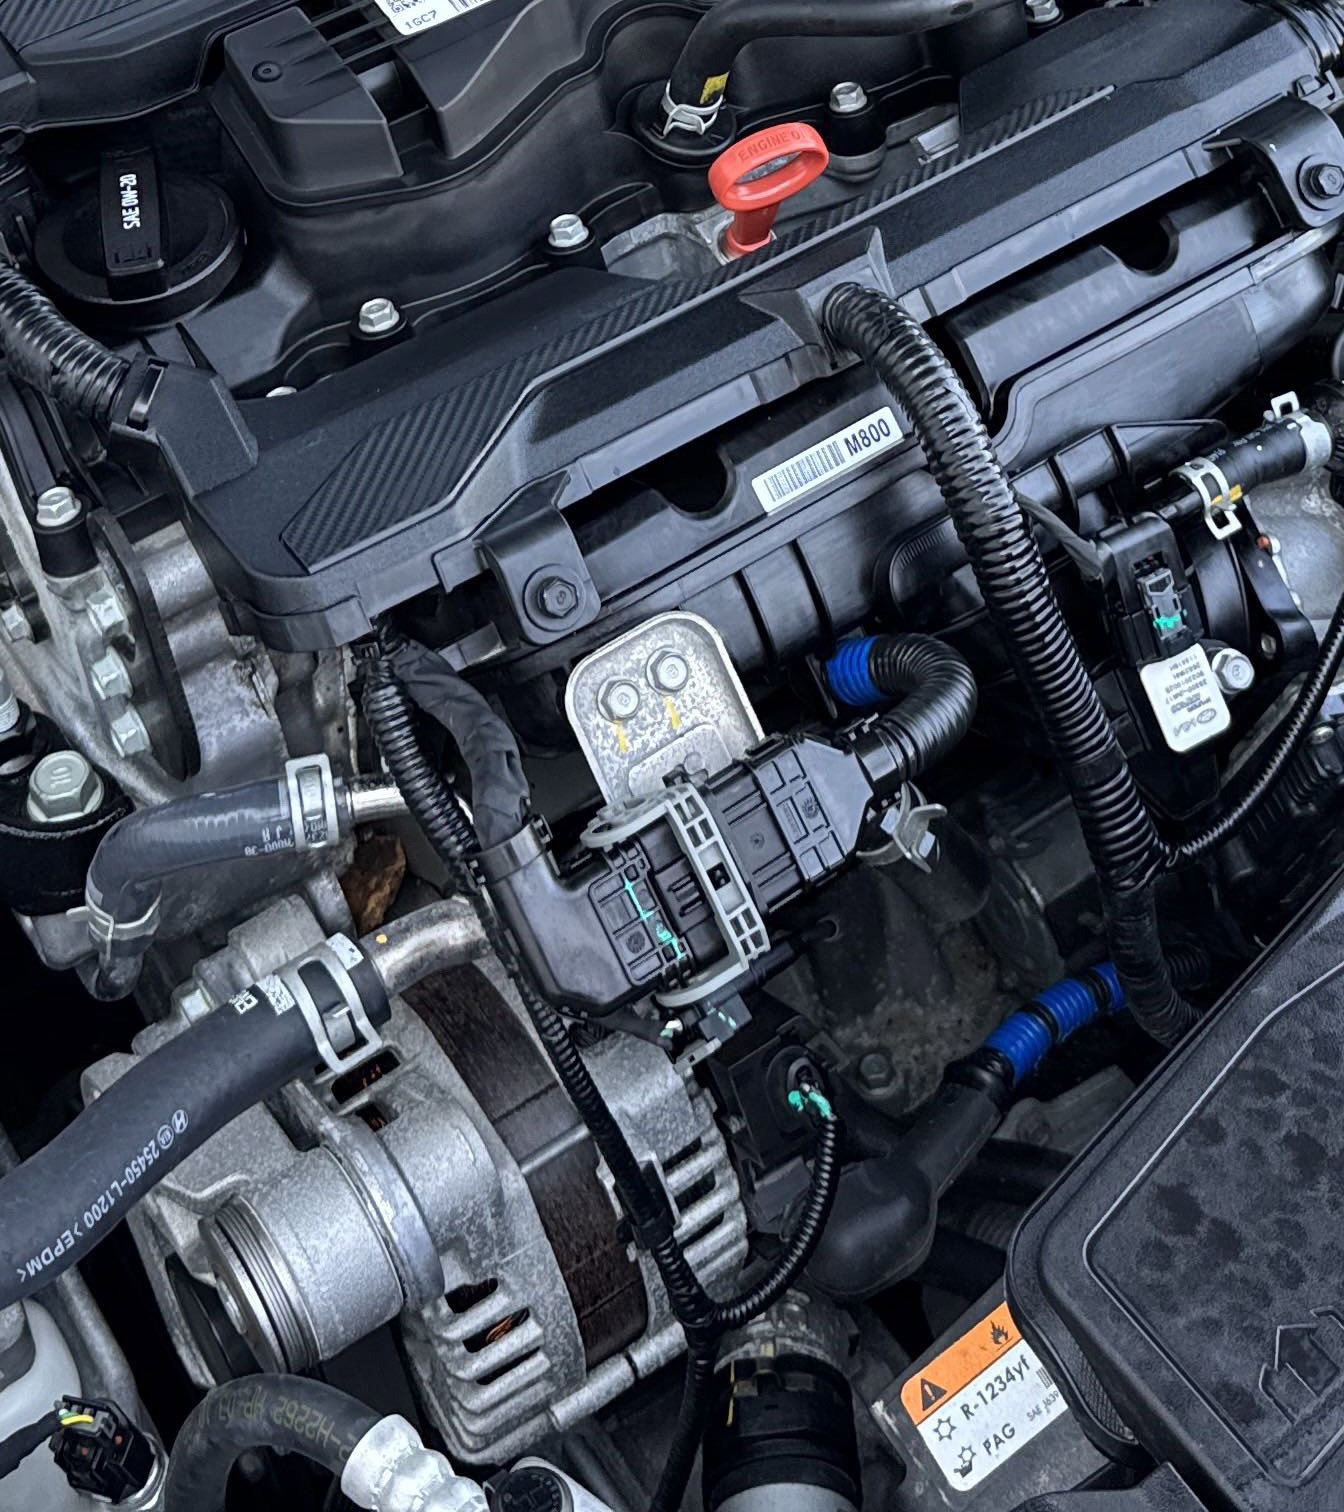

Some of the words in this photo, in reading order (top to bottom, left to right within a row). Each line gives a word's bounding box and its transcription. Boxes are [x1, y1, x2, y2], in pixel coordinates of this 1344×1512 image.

[405, 10, 438, 30] 1GC7
[738, 132, 789, 162] ENGINE
[119, 173, 139, 208] 0W-20
[122, 207, 141, 231] SAE
[844, 418, 891, 456] M800
[83, 1140, 160, 1231] 25450-L1200
[960, 1354, 1031, 1421] R-1234yf
[1026, 1404, 1043, 1422] SAE
[982, 1422, 1017, 1457] PAG
